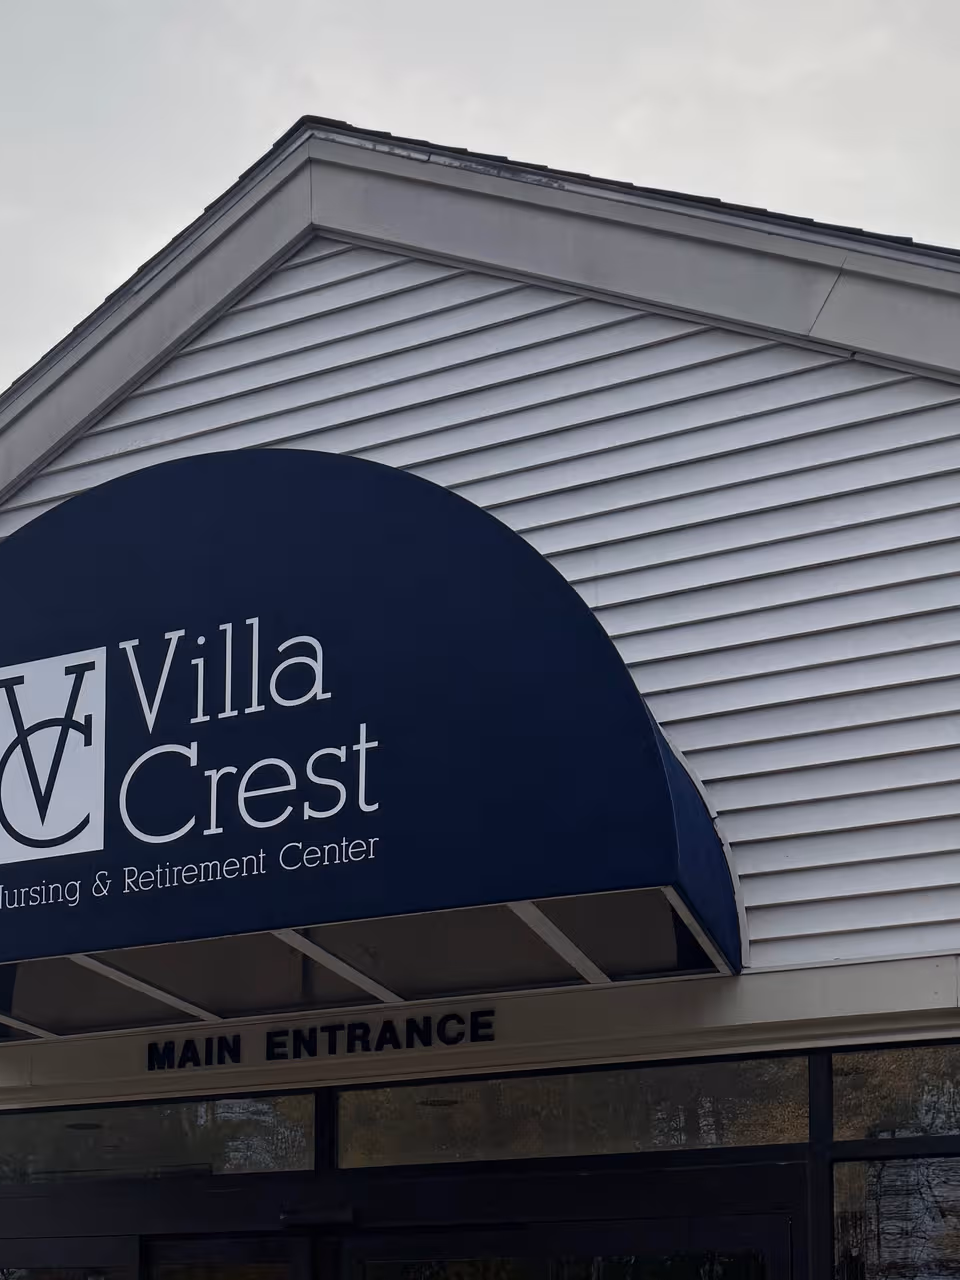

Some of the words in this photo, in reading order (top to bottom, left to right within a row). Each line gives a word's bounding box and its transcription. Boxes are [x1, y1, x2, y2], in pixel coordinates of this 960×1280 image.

[119, 617, 332, 735] Villa
[119, 723, 379, 844] Crest
[91, 871, 112, 897] &
[122, 849, 266, 894] Retirement
[279, 837, 380, 871] Center
[147, 1034, 241, 1072] MAIN
[266, 1009, 496, 1061] ENTRANCE
